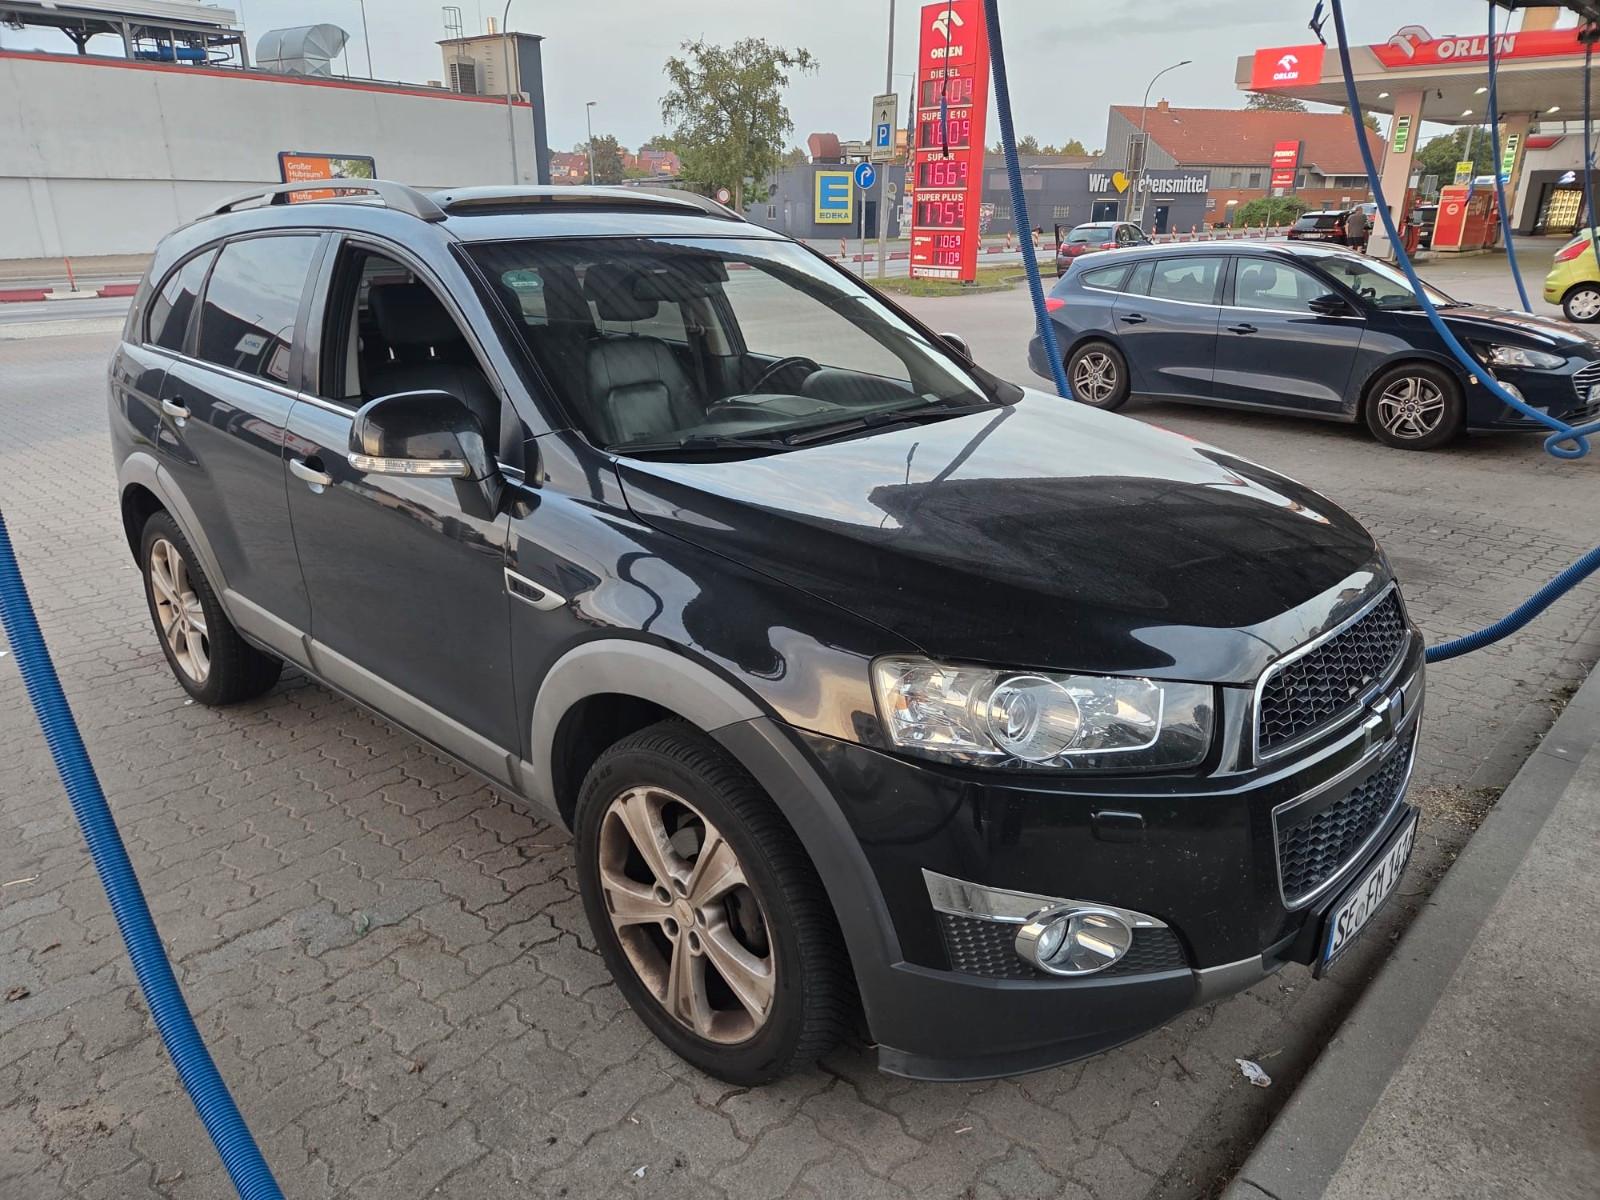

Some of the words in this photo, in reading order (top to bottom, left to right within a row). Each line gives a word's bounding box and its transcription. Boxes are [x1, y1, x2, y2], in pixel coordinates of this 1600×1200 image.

[1437, 35, 1516, 59] ORLEN
[1273, 71, 1299, 80] ORLEN
[921, 111, 943, 121] SUPE
[950, 110, 967, 119] E10
[287, 162, 312, 170] Großer
[1089, 173, 1111, 193] Wir
[917, 193, 940, 201] SUPER
[941, 193, 964, 201] PLUS
[1334, 897, 1358, 951] SE
[1365, 861, 1387, 916] FM
